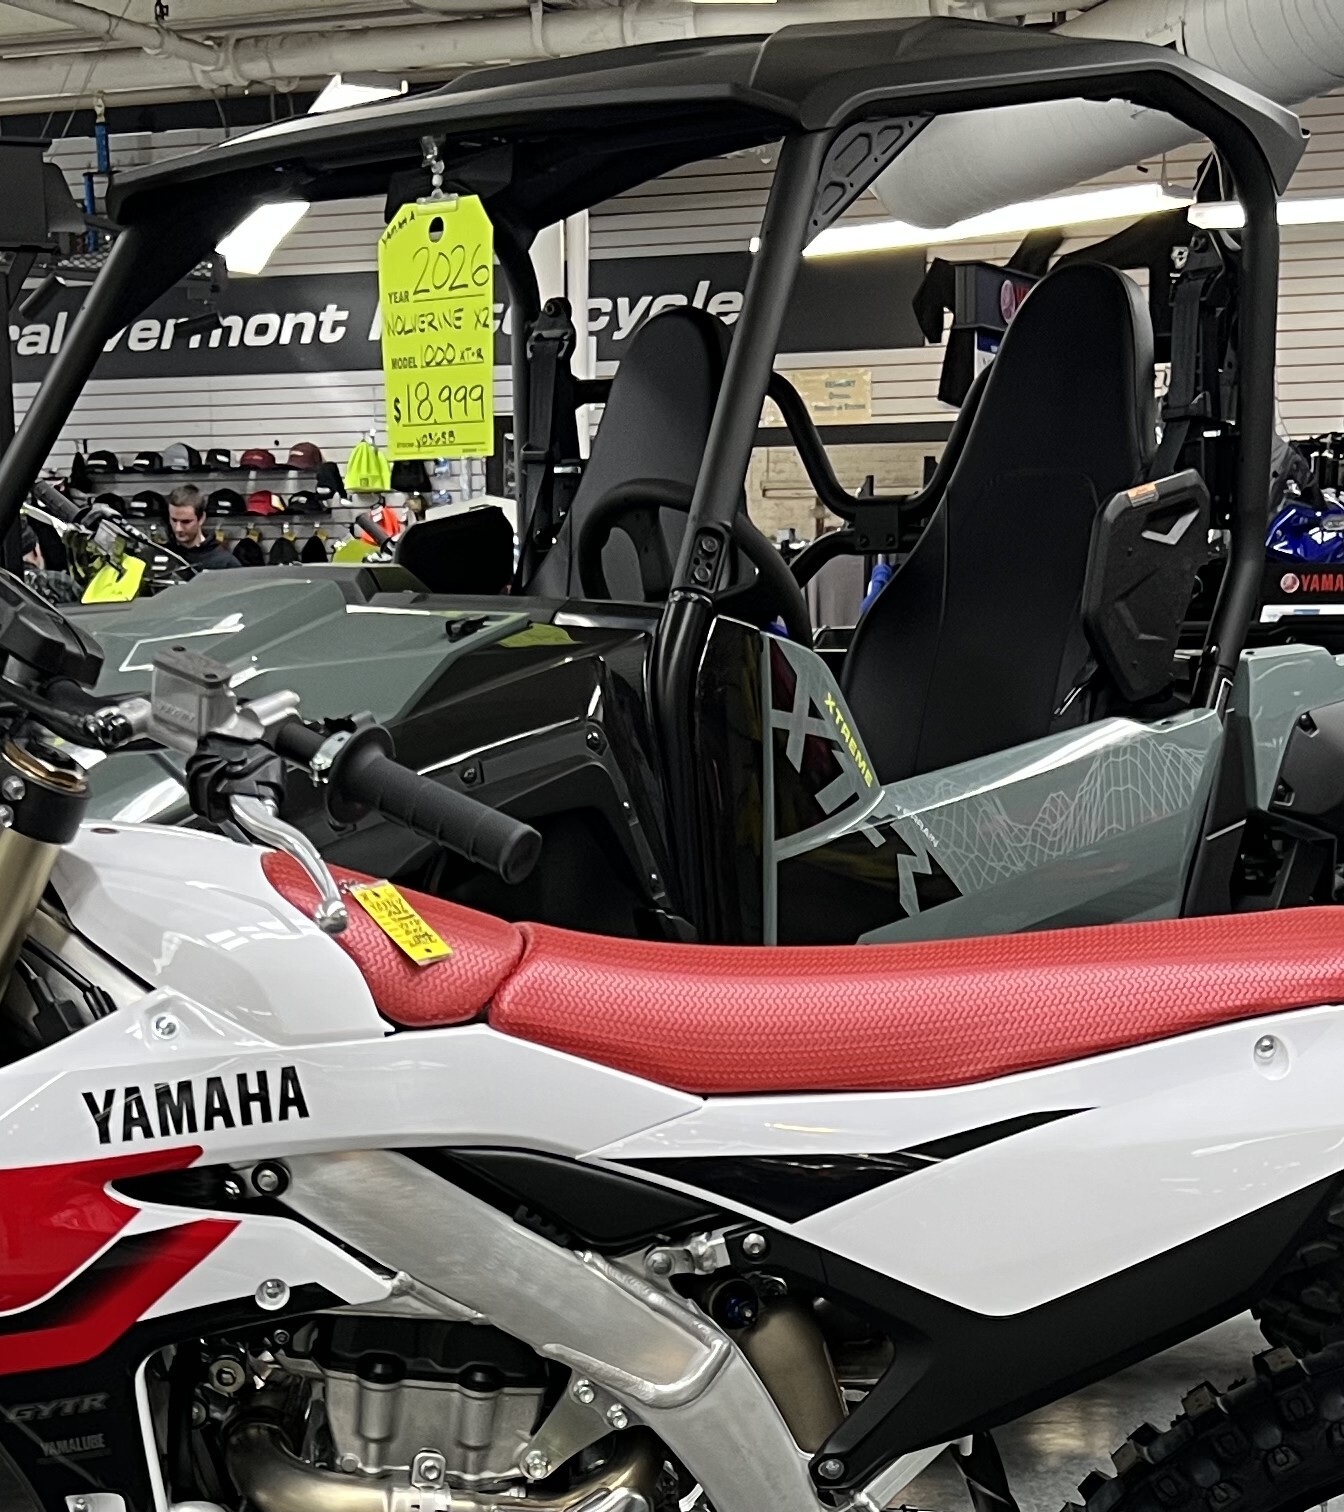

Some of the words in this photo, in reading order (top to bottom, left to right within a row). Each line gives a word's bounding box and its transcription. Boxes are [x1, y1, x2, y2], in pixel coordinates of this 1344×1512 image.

[388, 290, 410, 304] YEAR
[412, 244, 490, 297] 2026
[385, 307, 464, 337] WOLVERINE
[473, 306, 490, 331] X2
[391, 356, 418, 370] MODEL
[824, 691, 874, 788] XTREME
[82, 1066, 311, 1145] YAMAHA
[6, 1392, 109, 1421] GYTR
[40, 1433, 106, 1457] YAMALUBE
